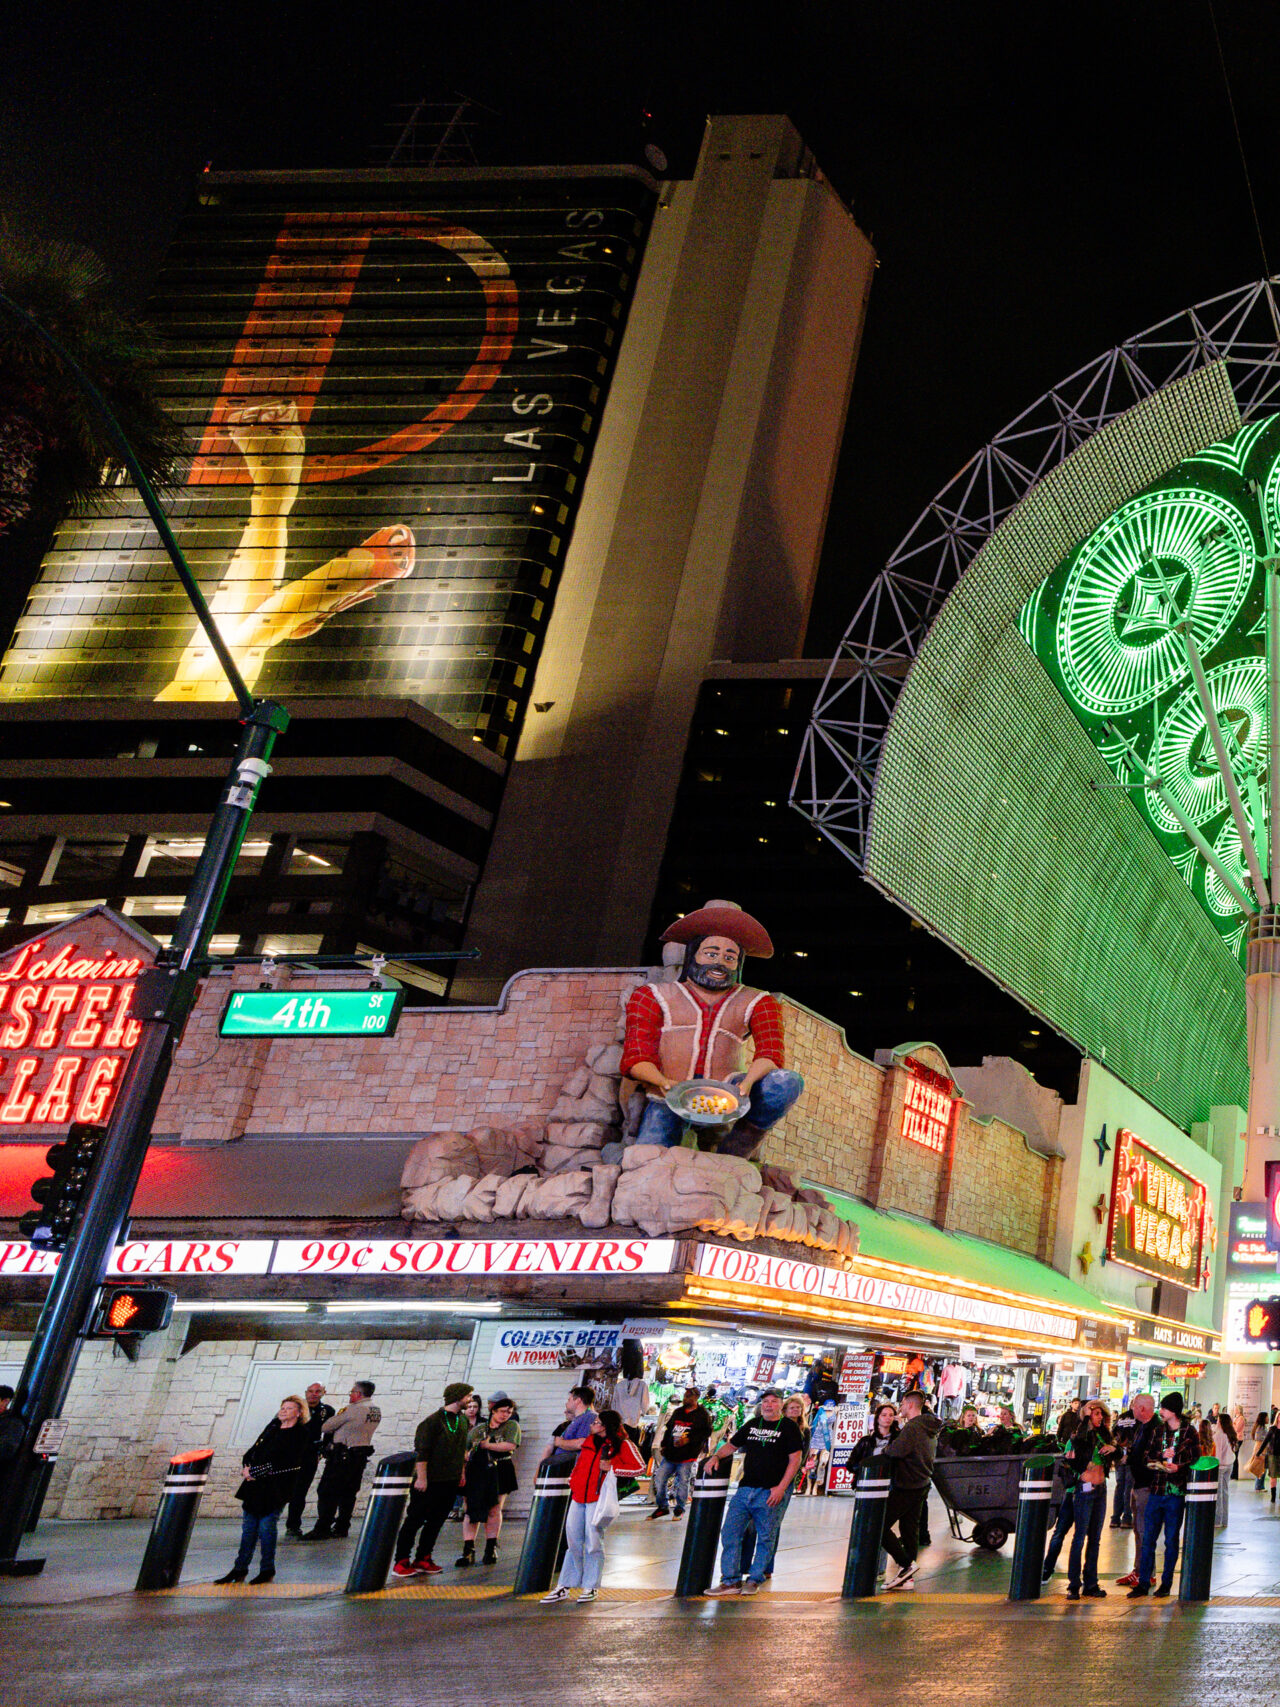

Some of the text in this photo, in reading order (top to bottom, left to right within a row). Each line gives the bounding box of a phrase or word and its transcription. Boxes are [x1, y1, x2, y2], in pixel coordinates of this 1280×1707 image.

[492, 207, 606, 484] LAS VEGAS
[0, 984, 142, 1048] STER
[233, 994, 383, 1028] N 4th St
[362, 1014, 386, 1030] 100
[0, 1056, 119, 1124] LAG
[904, 1077, 952, 1127] WESTERN
[902, 1109, 946, 1153] VILLAGE
[1146, 1160, 1188, 1224] VIVA
[1134, 1204, 1193, 1270] VEGAS
[116, 1242, 241, 1273] GARS
[298, 1241, 648, 1273] 99¢ SOUVENIRS
[706, 1245, 821, 1294] TOBACCO
[827, 1268, 949, 1318] 4X10 T-SHIRTS
[500, 1329, 619, 1348] COLDEST BEER
[621, 1324, 665, 1336] Luggage
[1153, 1326, 1173, 1343] HATS
[1176, 1331, 1203, 1349] LIQUOR
[507, 1350, 559, 1365] IN TOWN
[1166, 1367, 1201, 1376] LIQUOR
[839, 1411, 865, 1420] T-SHIRTS
[851, 1403, 866, 1411] VEGAS
[749, 1427, 782, 1438] TRIUMPH
[837, 1430, 863, 1444] $9.99
[838, 1420, 864, 1431] 4 FOR
[834, 1450, 852, 1459] DISCO
